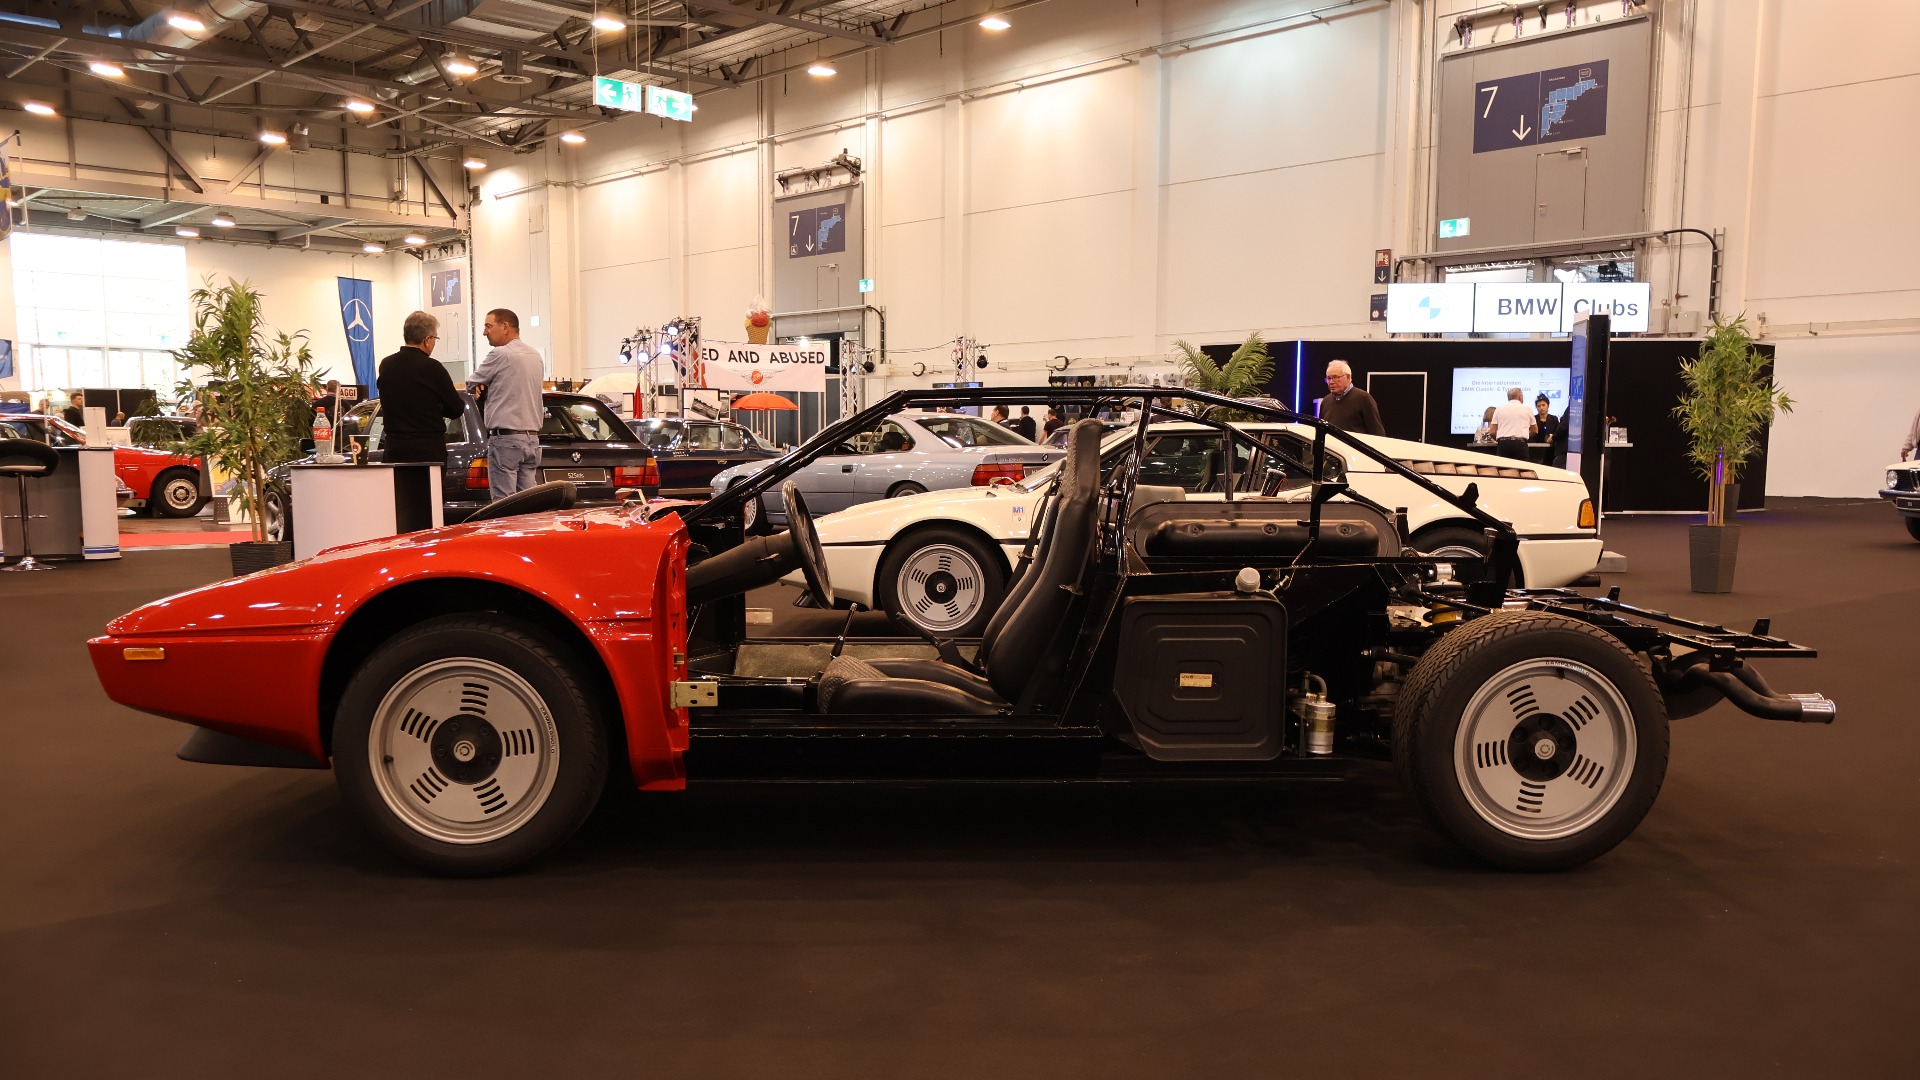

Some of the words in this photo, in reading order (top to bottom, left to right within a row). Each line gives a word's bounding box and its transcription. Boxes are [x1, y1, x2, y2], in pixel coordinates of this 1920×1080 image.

[1481, 86, 1499, 119] 7
[791, 215, 800, 236] 7
[431, 275, 437, 291] 7
[1497, 298, 1558, 316] BMW
[1573, 298, 1639, 316] Clubs
[728, 350, 760, 364] AND
[769, 351, 825, 364] ABUSED
